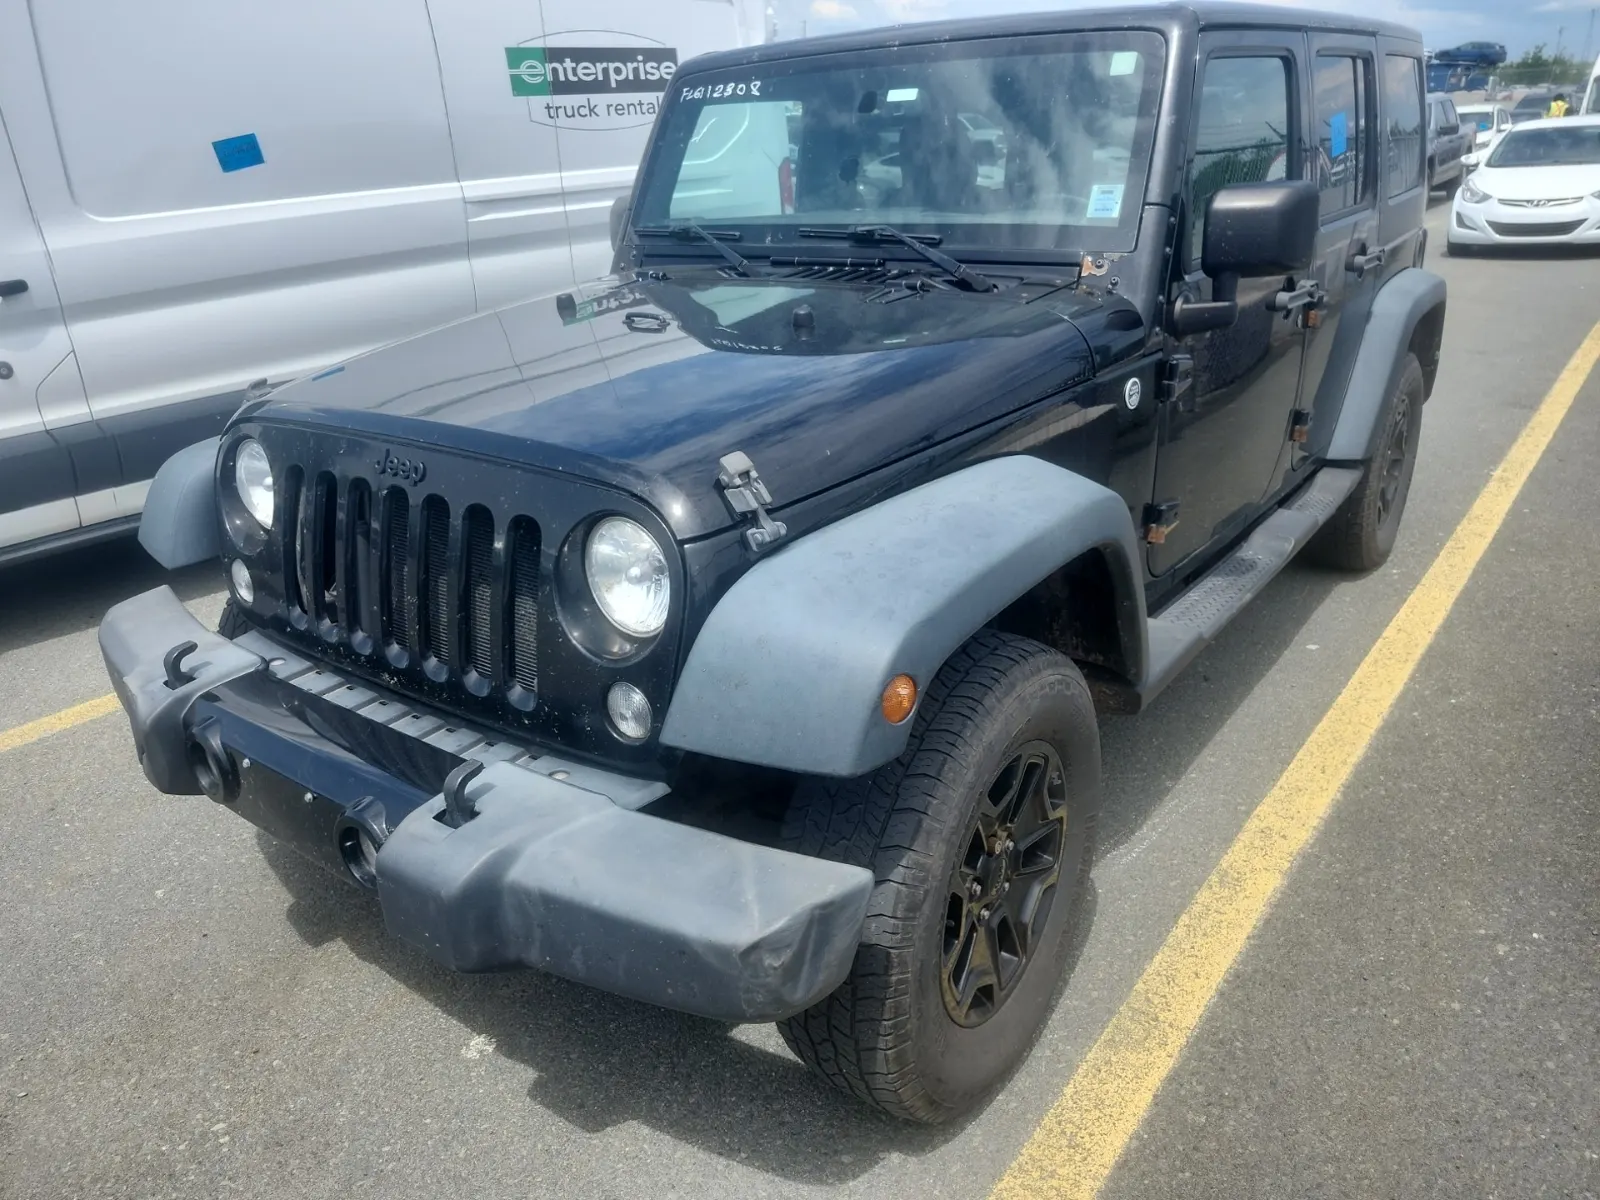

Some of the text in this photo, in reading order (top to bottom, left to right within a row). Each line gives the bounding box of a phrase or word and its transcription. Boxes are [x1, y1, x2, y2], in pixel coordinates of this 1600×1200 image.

[509, 55, 676, 88] enterprise
[544, 95, 660, 119] truck rental
[375, 448, 427, 487] Jeep
